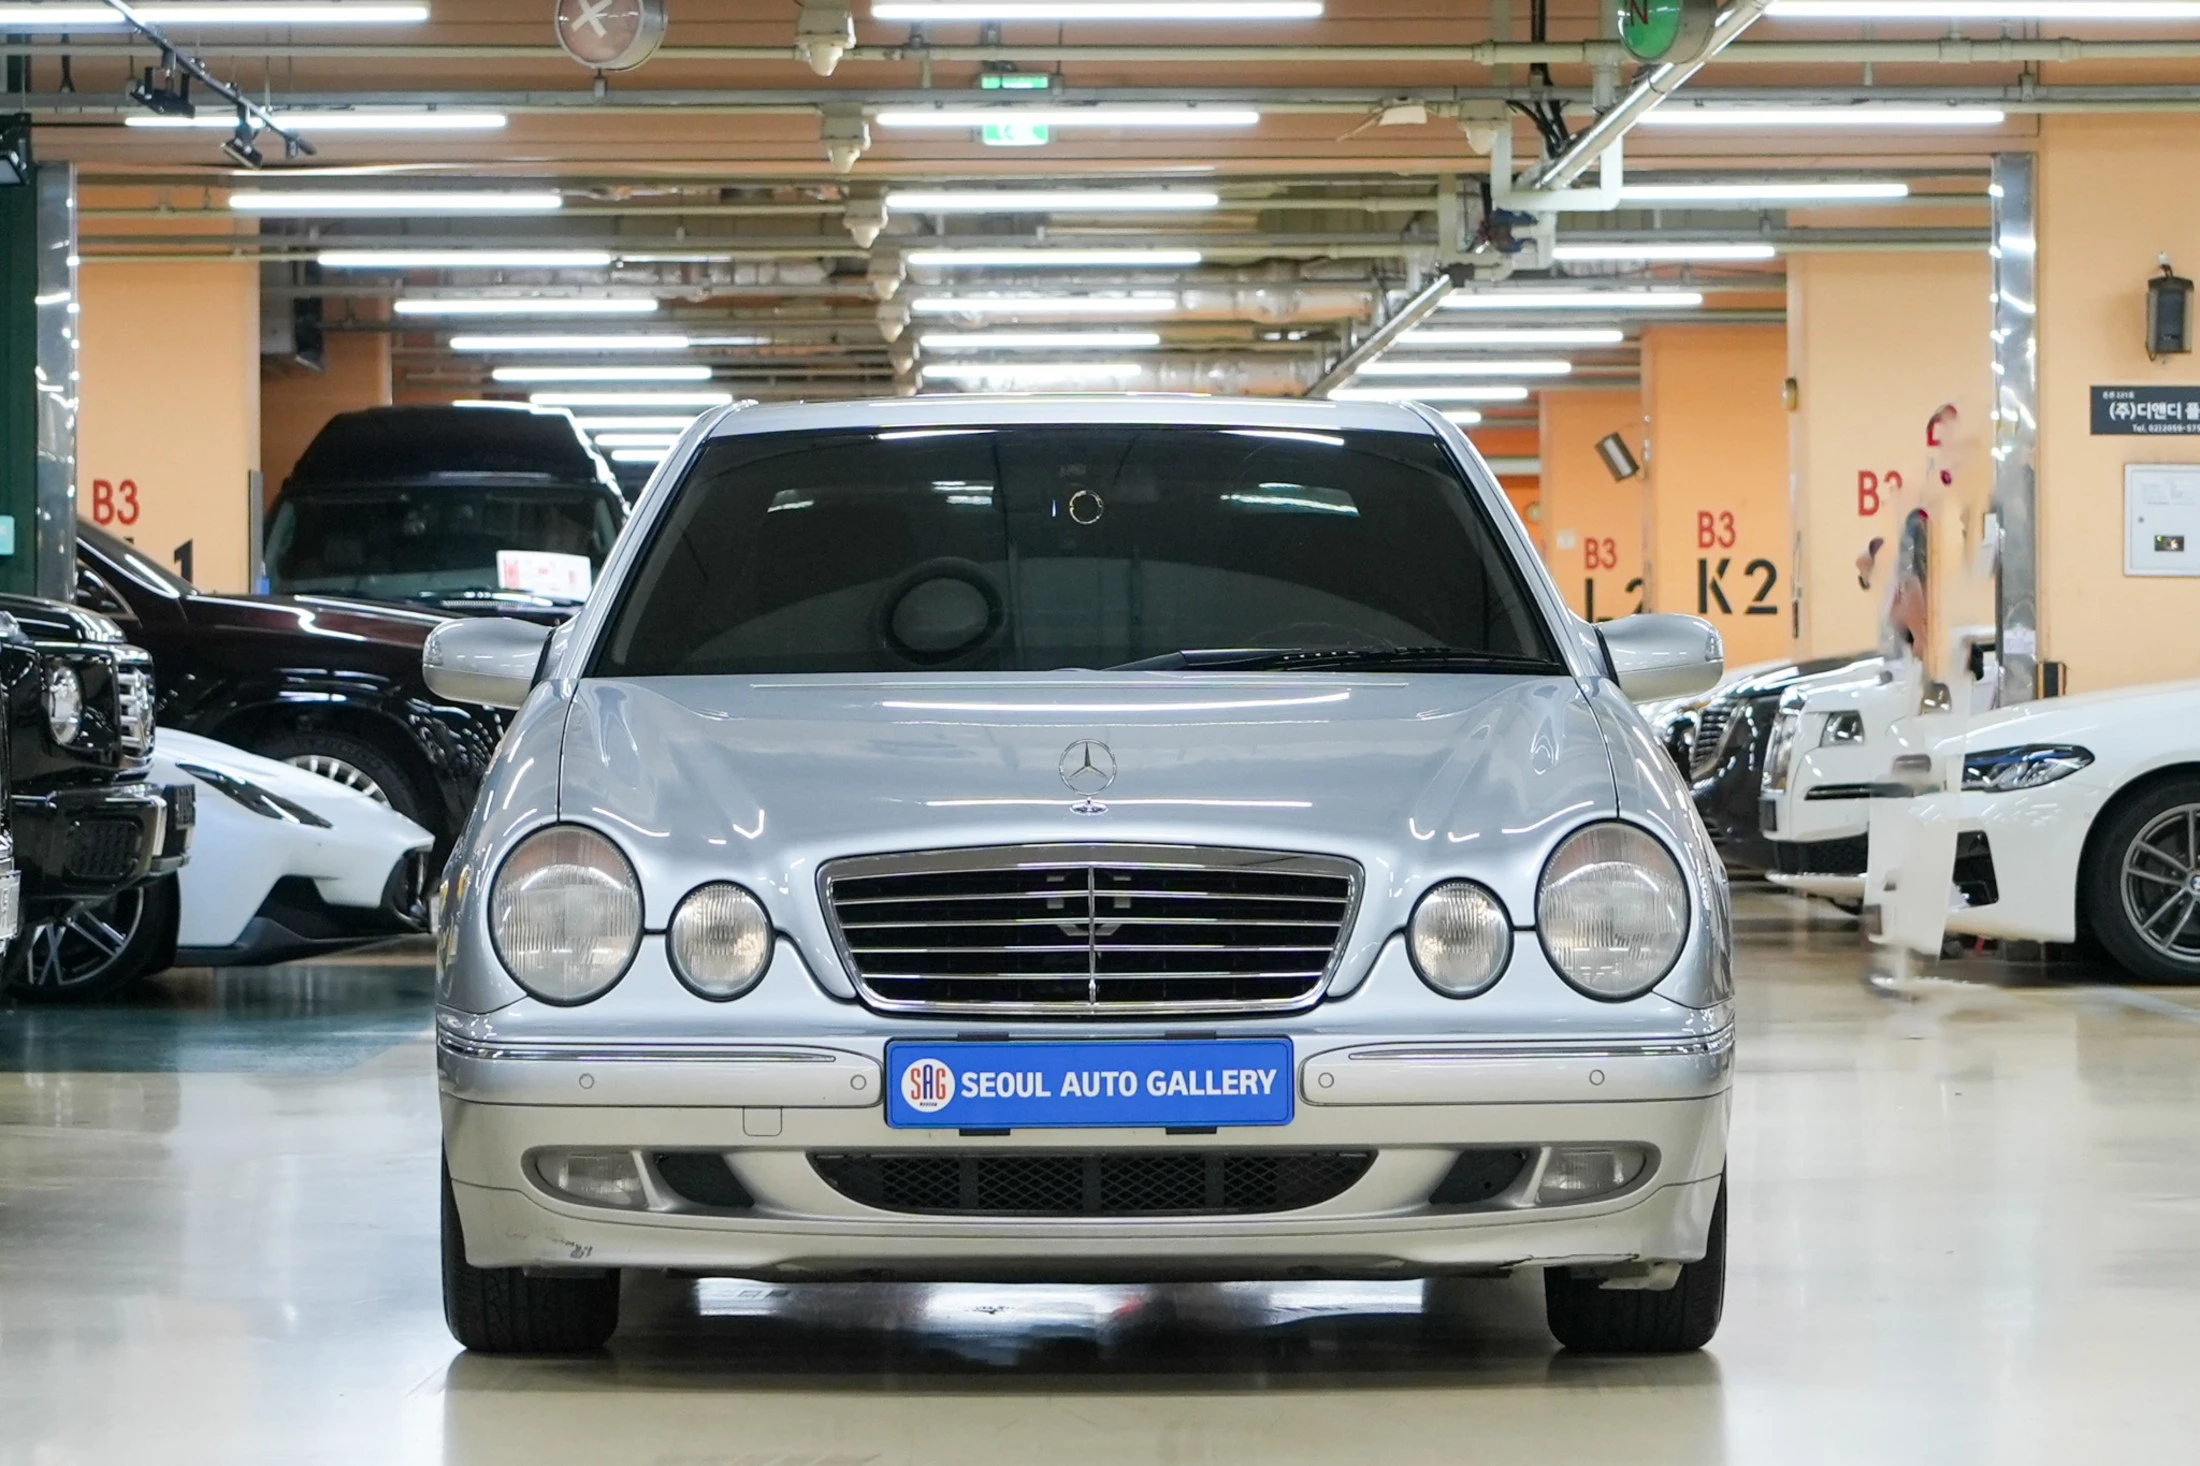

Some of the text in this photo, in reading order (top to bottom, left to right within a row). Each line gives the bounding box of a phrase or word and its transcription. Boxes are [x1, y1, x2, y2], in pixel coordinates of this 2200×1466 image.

[93, 479, 140, 525] B3
[1697, 510, 1735, 549] B3
[1585, 537, 1617, 570] B3
[1698, 557, 1777, 615] K2
[910, 1064, 947, 1101] SAG
[961, 1069, 1277, 1098] SEOUL AUTO GALLERY
